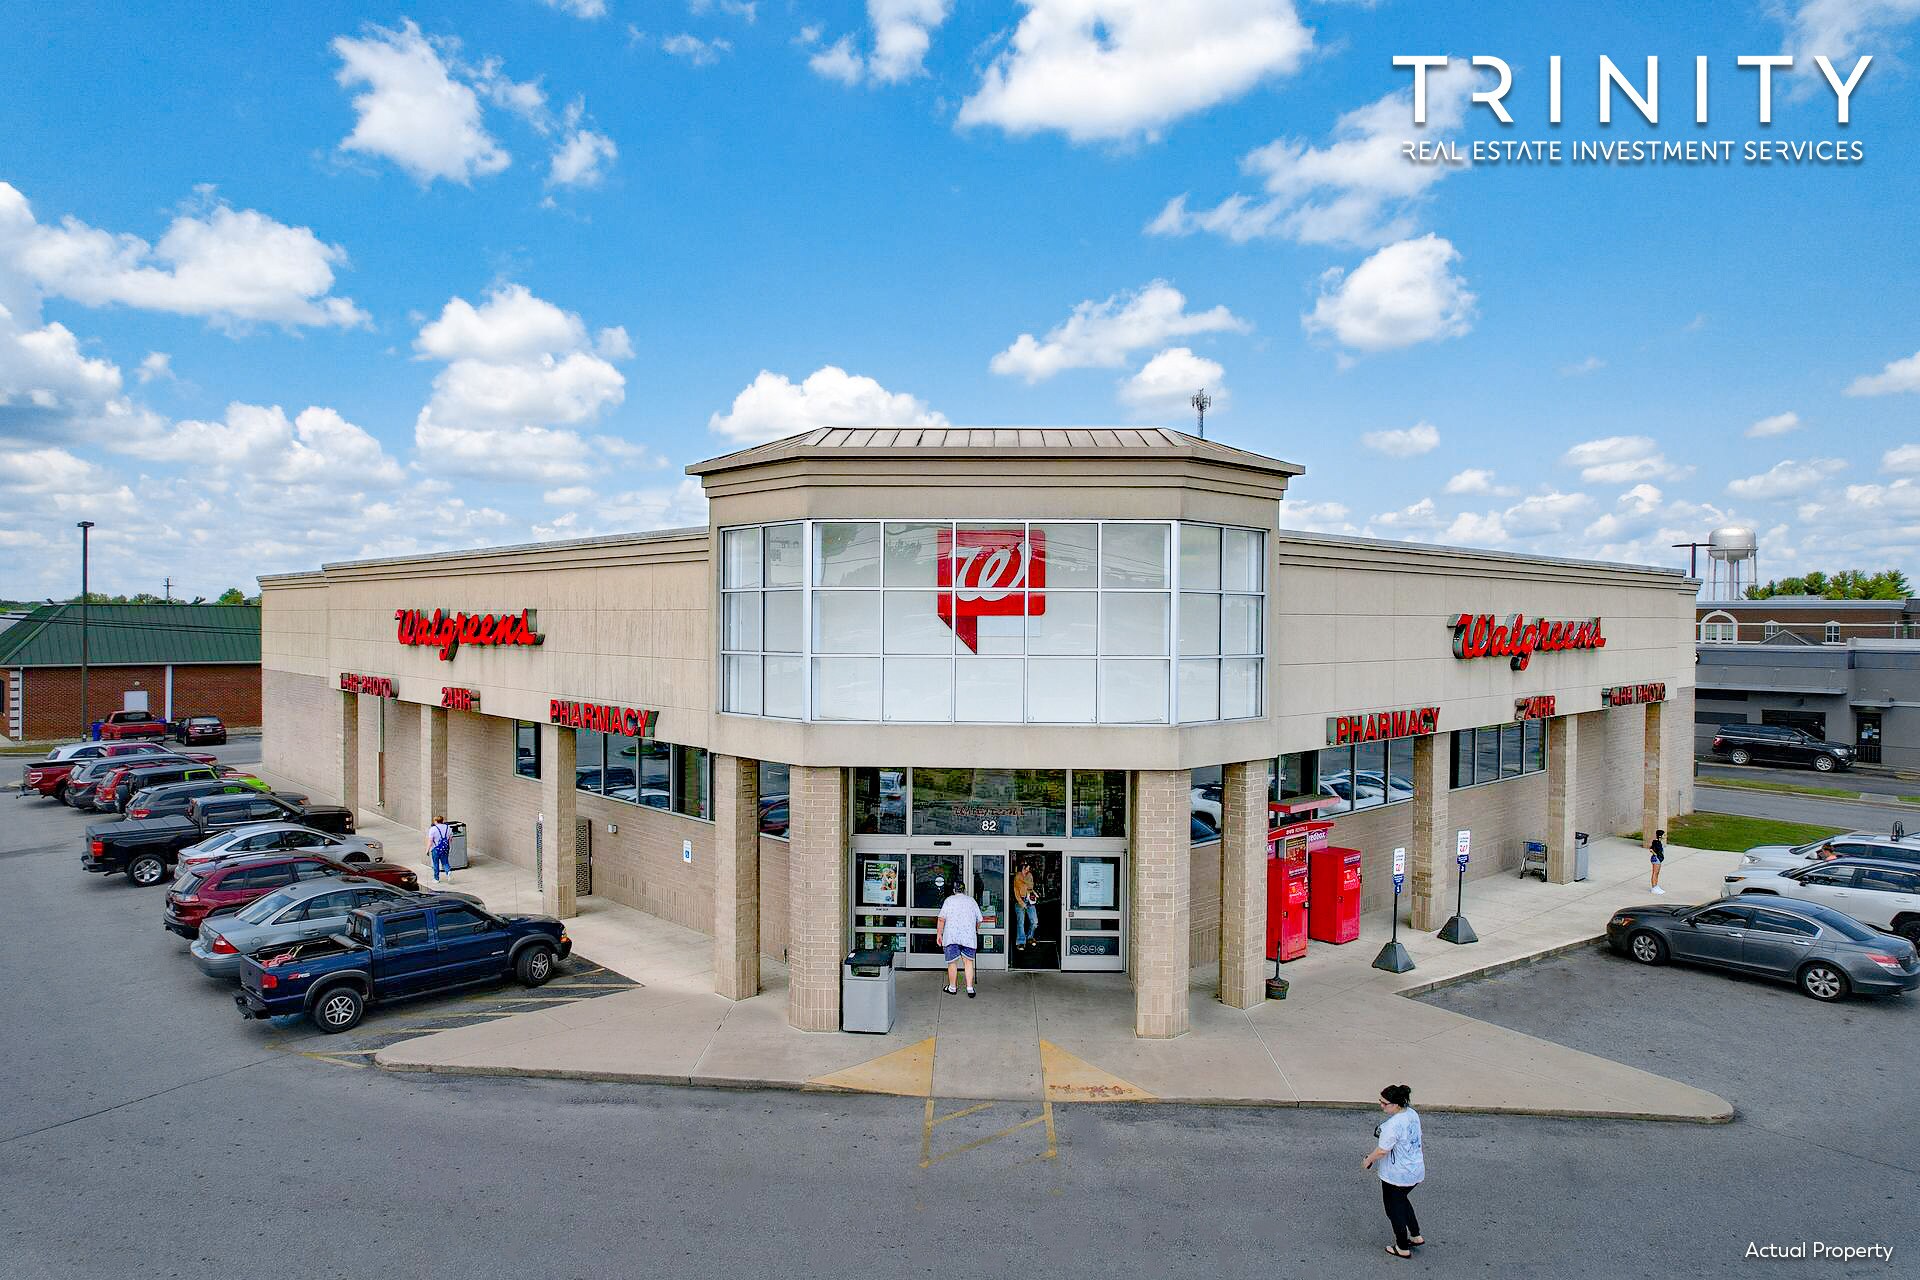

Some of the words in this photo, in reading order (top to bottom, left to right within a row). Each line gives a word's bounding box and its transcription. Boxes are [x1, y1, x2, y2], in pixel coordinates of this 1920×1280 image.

[395, 608, 540, 661] Walgreens
[1450, 613, 1606, 671] Walgreens
[551, 699, 652, 737] PHARMACY
[1336, 706, 1441, 746] PHARMACY
[981, 820, 997, 832] 82
